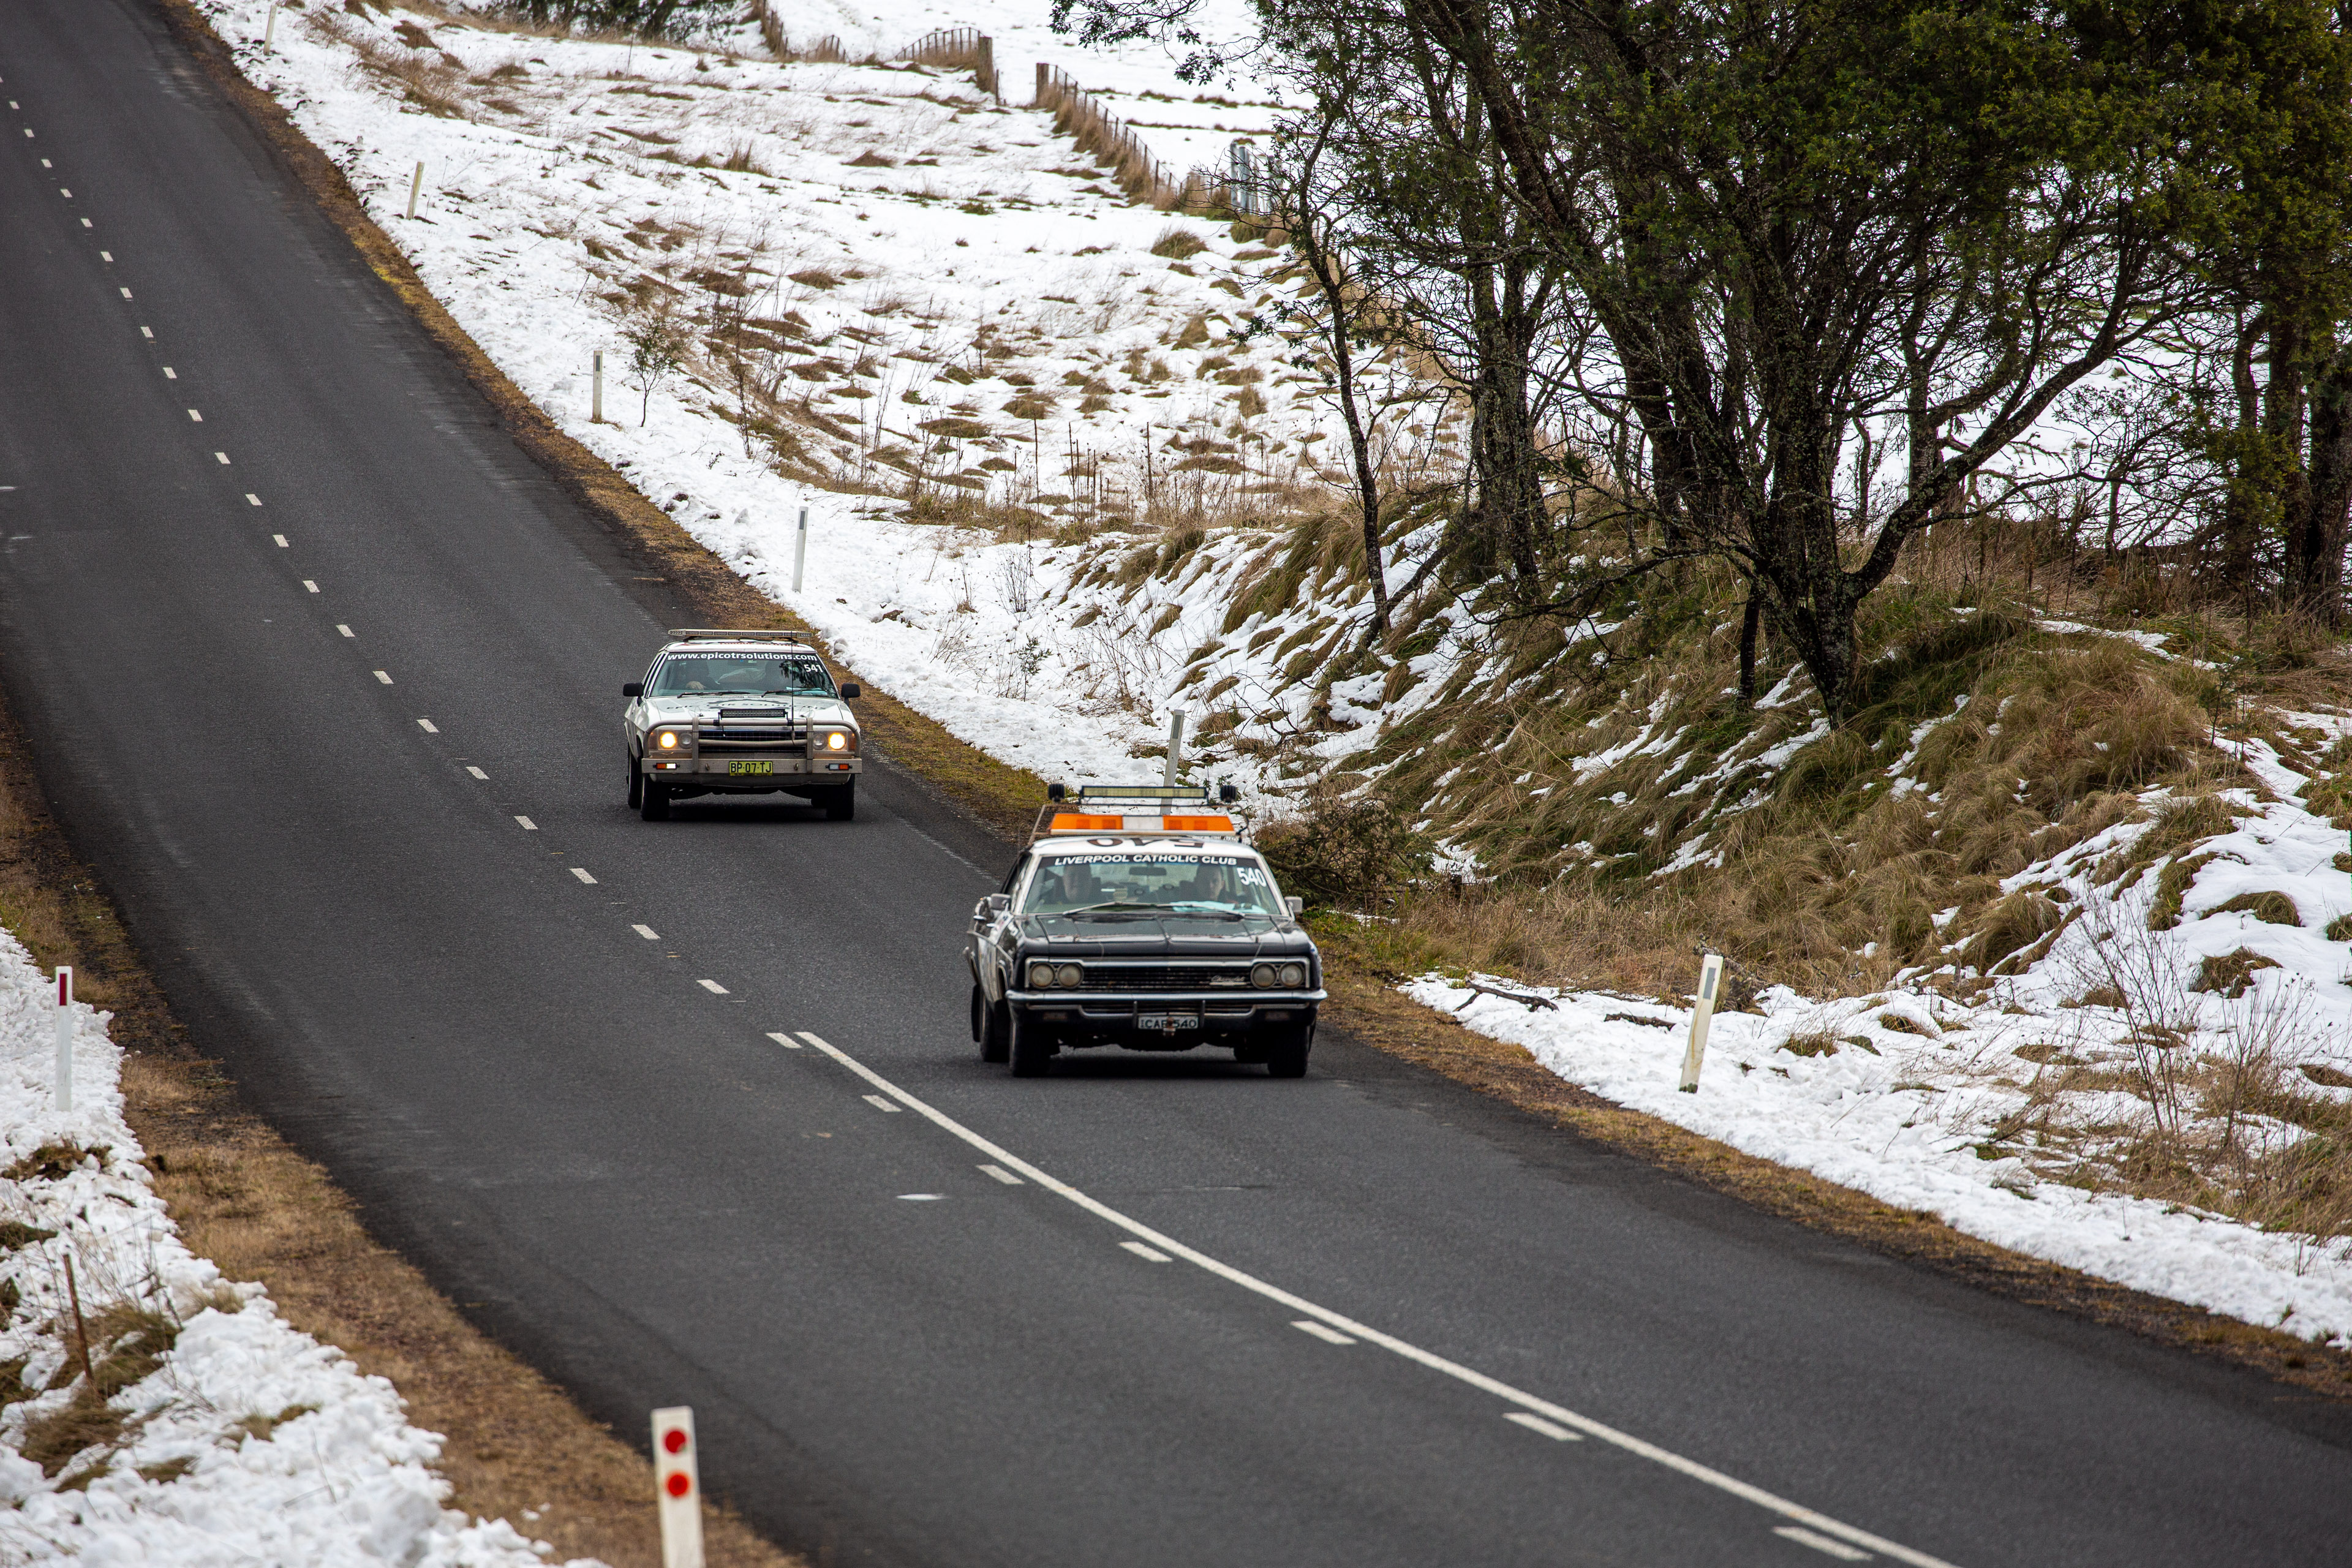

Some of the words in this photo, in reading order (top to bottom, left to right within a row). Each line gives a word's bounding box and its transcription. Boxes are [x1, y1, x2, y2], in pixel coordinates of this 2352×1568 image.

[668, 652, 817, 661] www.epicotrsolutions.com
[804, 664, 823, 673] 541
[1055, 854, 1129, 865] LIVERPOOL
[1201, 856, 1237, 865] CLUB
[1237, 867, 1267, 887] 540
